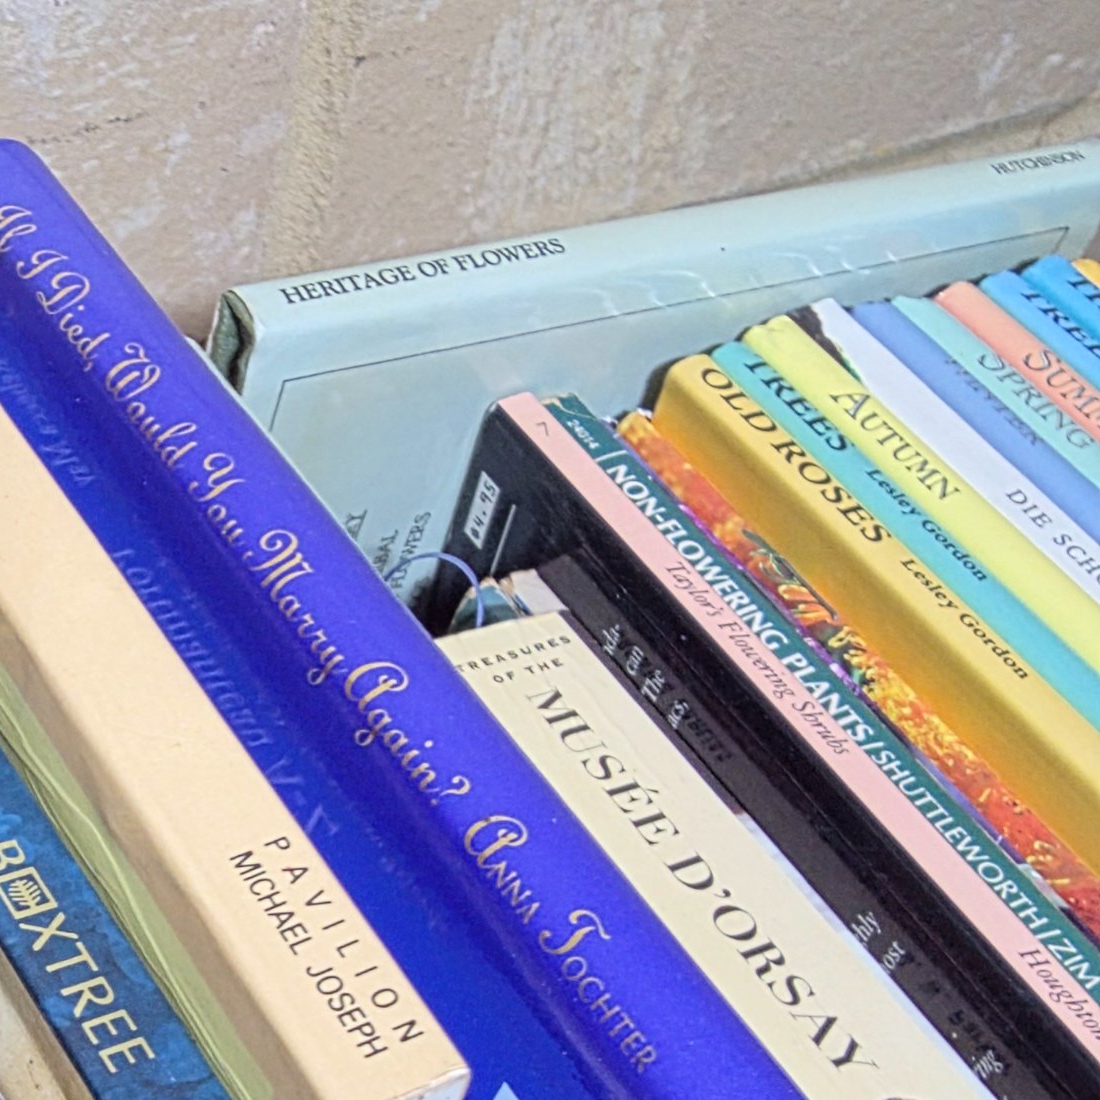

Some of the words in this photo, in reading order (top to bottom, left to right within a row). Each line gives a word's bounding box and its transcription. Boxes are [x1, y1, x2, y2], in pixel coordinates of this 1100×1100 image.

[990, 150, 1086, 175] HUTCHINSON
[281, 266, 416, 304] HERITAGE
[417, 258, 449, 278] OF
[451, 238, 566, 272] FLOWERS
[830, 391, 962, 501] AUTUMN
[977, 352, 1096, 450] SPRING
[105, 342, 197, 469] Would
[242, 529, 347, 686] Marry
[344, 661, 471, 806] Again?
[606, 464, 788, 651] NON-FLOWERING
[701, 367, 778, 433] OLD
[770, 440, 892, 544] ROSES
[900, 558, 960, 610] Lesley
[959, 612, 1030, 681] Gordon
[865, 468, 922, 517] Lesley
[921, 518, 988, 581] Gordon
[1005, 488, 1053, 529] DIE
[1051, 533, 1100, 586] SCH
[456, 635, 572, 672] TREASURES
[493, 671, 515, 684] OF
[526, 658, 563, 674] THE
[718, 619, 795, 700] Flowering
[791, 700, 851, 757] Shrubs
[526, 687, 680, 846] MUSÉE
[229, 850, 313, 955] MICHAEL
[306, 965, 389, 1059] JOSEPH
[264, 836, 425, 1043] PAVILION
